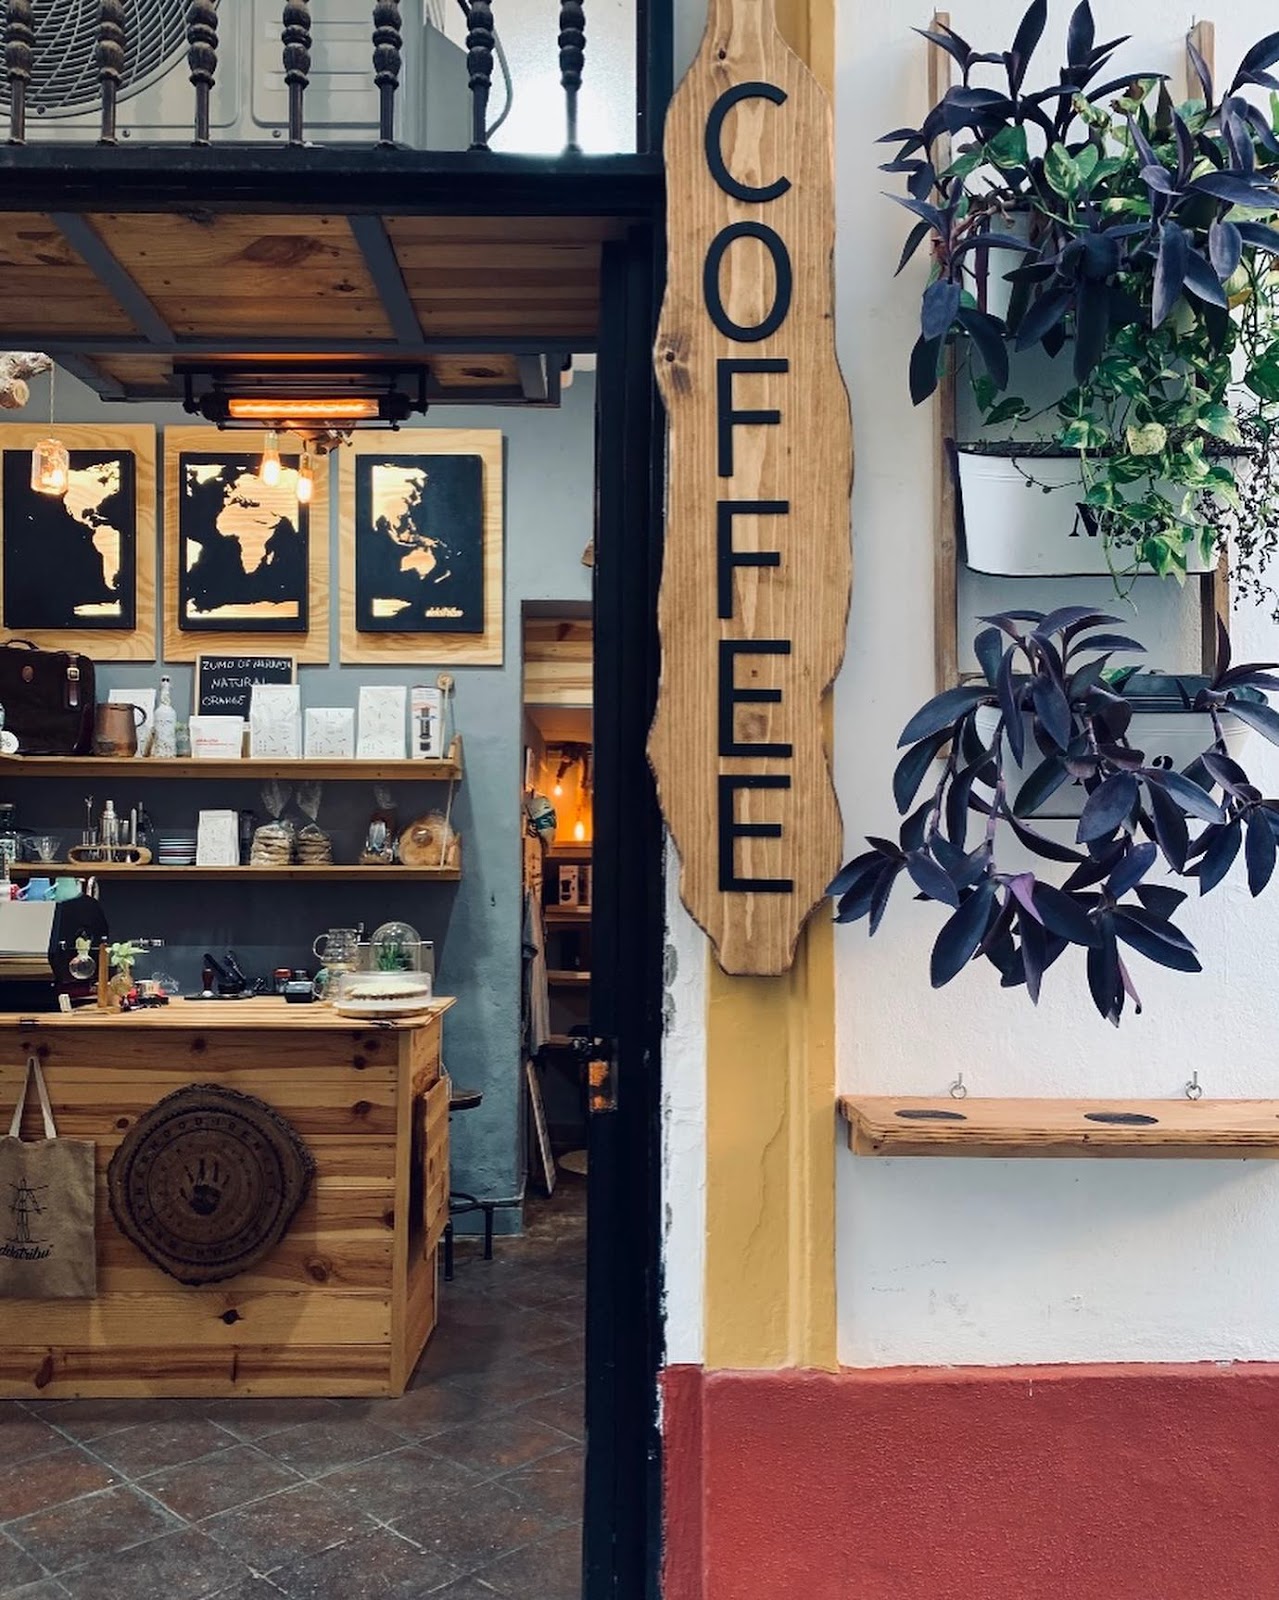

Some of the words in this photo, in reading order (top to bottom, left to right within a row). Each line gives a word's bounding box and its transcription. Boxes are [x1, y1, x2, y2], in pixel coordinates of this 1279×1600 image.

[704, 82, 795, 895] COFFEE
[202, 660, 234, 670] ZUMO
[202, 695, 245, 706] ORANGE
